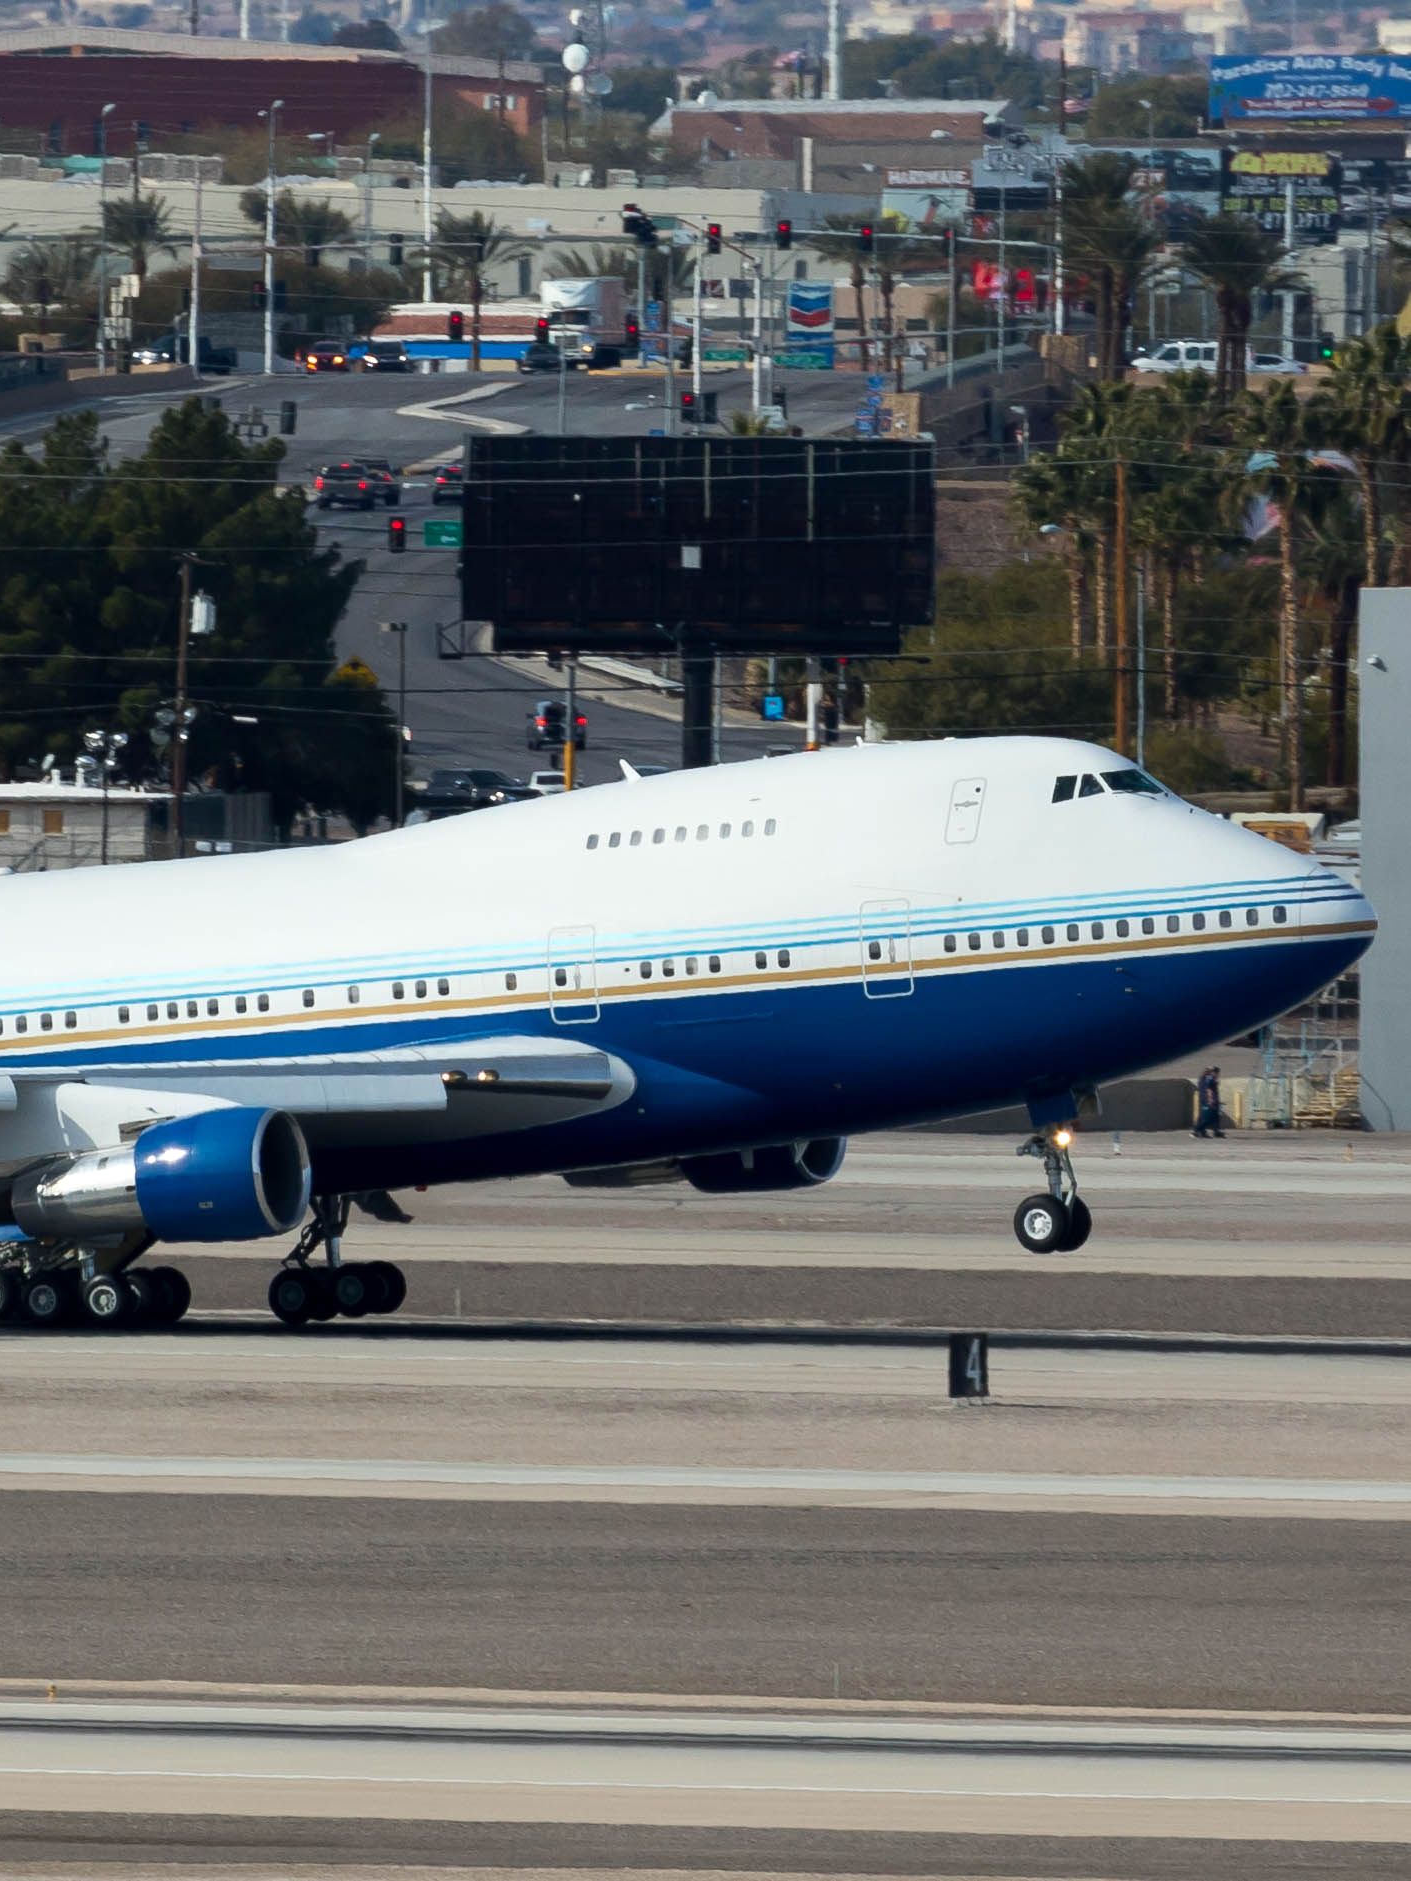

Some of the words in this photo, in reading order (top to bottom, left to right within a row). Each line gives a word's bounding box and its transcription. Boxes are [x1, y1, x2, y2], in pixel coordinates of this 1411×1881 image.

[1211, 60, 1289, 81] Paradise
[1292, 56, 1336, 70] Auto
[1340, 56, 1385, 78] Body
[965, 1338, 982, 1393] 4
